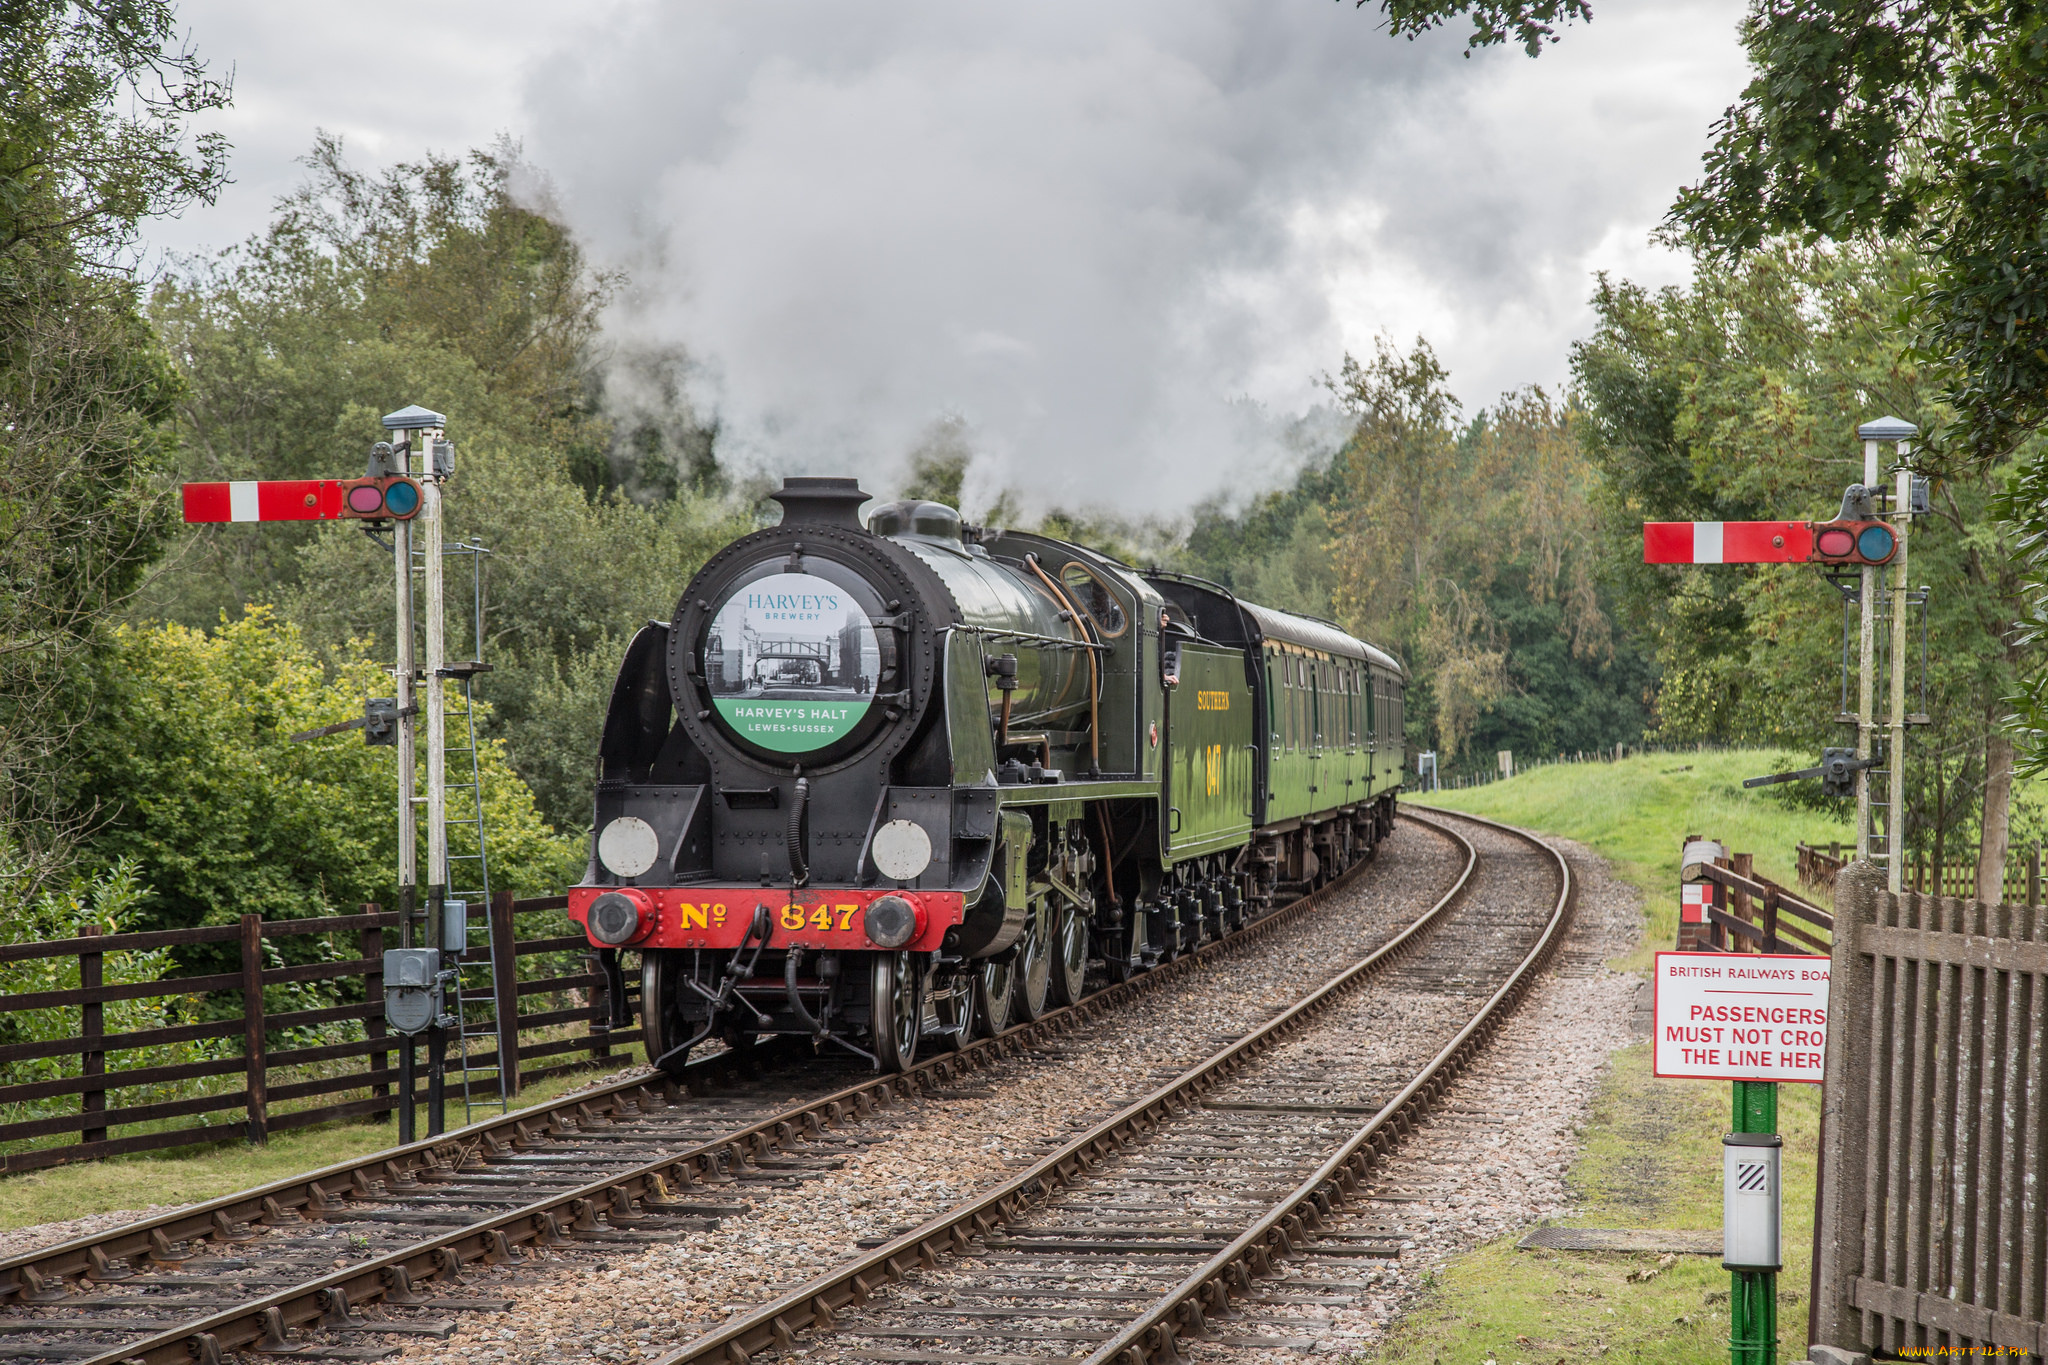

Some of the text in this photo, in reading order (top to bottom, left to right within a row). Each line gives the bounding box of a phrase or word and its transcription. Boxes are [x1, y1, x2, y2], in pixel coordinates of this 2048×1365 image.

[748, 594, 838, 610] HARVEY'S
[765, 612, 820, 620] BREWERY
[1198, 690, 1229, 710] SOUTHERN
[735, 707, 848, 720] HARVEY'S HALT
[1206, 744, 1221, 797] 847
[780, 904, 860, 930] 847
[1669, 966, 1830, 981] BRITISH RAILWAYS BOA
[1690, 1005, 1826, 1024] PASSENGERS
[1666, 1026, 1824, 1046] MUST NOT CRO
[1681, 1048, 1822, 1068] THE LINE HER
